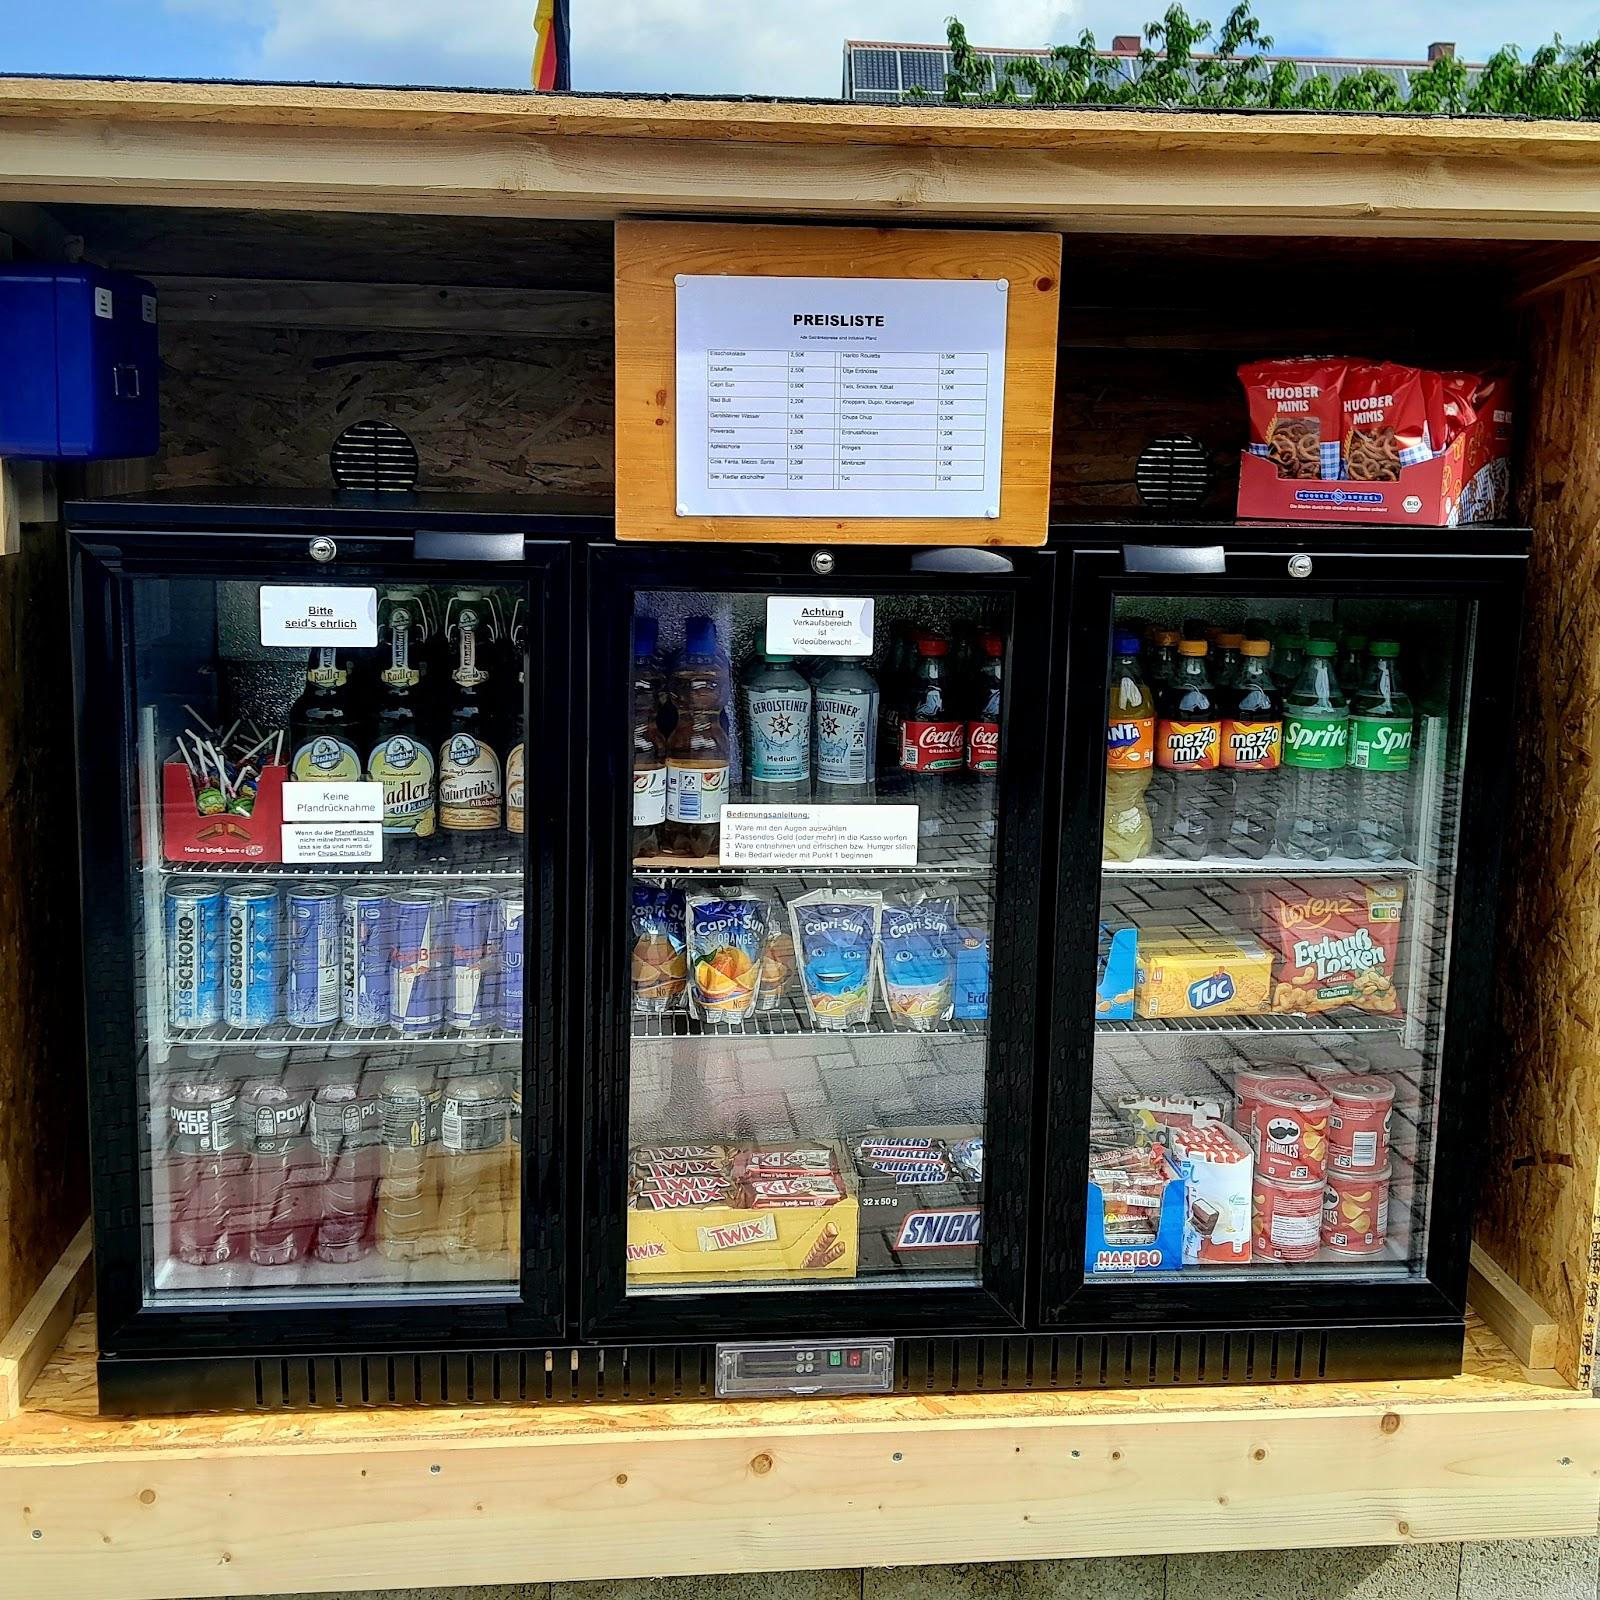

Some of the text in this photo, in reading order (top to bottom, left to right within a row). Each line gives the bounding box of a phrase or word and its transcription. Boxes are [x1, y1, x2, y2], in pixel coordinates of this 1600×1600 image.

[793, 314, 885, 327] PREISLISTE
[1266, 385, 1319, 399] HUOBER
[1277, 399, 1310, 413] MINIS
[1343, 394, 1394, 412] HUOBER
[1353, 409, 1385, 425] MINIS
[308, 605, 334, 616] Bitte
[801, 606, 844, 618] Achtung
[285, 617, 357, 629] seid's ehrlich
[793, 618, 853, 628] Verkaufsbereich
[817, 628, 827, 637] ist
[792, 637, 852, 647] Videoüberwacht
[1168, 727, 1217, 748] mezzo
[1230, 727, 1278, 748] mezzo
[1285, 722, 1347, 750] Sprite
[1174, 742, 1207, 761] mix
[1236, 740, 1269, 760] mix
[766, 755, 798, 763] Medium
[322, 792, 350, 801] Keine
[384, 780, 427, 805] adler
[297, 803, 376, 815] Pfandrücknahme
[726, 811, 810, 820] Bedienungsanleitung:
[734, 824, 755, 832] Ware
[756, 824, 767, 832] mit
[768, 824, 783, 832] den
[784, 824, 807, 833] Augen
[808, 824, 847, 832] auswählen
[735, 833, 775, 841] Passendes
[776, 833, 794, 841] Geld
[795, 833, 815, 842] (oder
[815, 833, 838, 842] mehr)
[883, 834, 908, 842] werfen
[734, 842, 754, 850] Ware
[755, 842, 796, 850] entnehmen
[797, 842, 811, 850] und
[812, 842, 848, 850] erfrischen
[849, 842, 865, 850] bzw.
[866, 842, 894, 852] Hunger
[895, 843, 916, 851] stillen
[734, 851, 747, 859] Bei
[748, 851, 773, 859] Bedarf
[773, 851, 798, 859] wieder
[799, 851, 811, 859] mit
[811, 851, 833, 859] Punkt
[840, 851, 874, 861] beginnen
[1279, 896, 1355, 929] Lorenz
[695, 914, 766, 936] Capri-Sun
[805, 917, 864, 936] Capri-Sun
[889, 918, 948, 938] Capri-Sun
[717, 932, 753, 945] ORANGE
[1293, 928, 1373, 968] Erdnuß
[178, 916, 194, 1018] EISSCHOKO
[230, 916, 243, 1018] EISSCHOKO
[343, 916, 355, 1017] EISKAFFEE
[1317, 946, 1386, 981] Locken
[1191, 980, 1230, 1007] TUC
[179, 1122, 210, 1135] ADE
[863, 1137, 931, 1147] SNICKERS
[1266, 1138, 1299, 1159] PRINGLES
[872, 1148, 940, 1160] SNICKERS
[874, 1161, 943, 1172] SNICKERS
[640, 1187, 726, 1211] TWIX
[863, 1198, 873, 1206] 32
[892, 1199, 898, 1207] g
[1099, 1250, 1161, 1268] HARIBO
